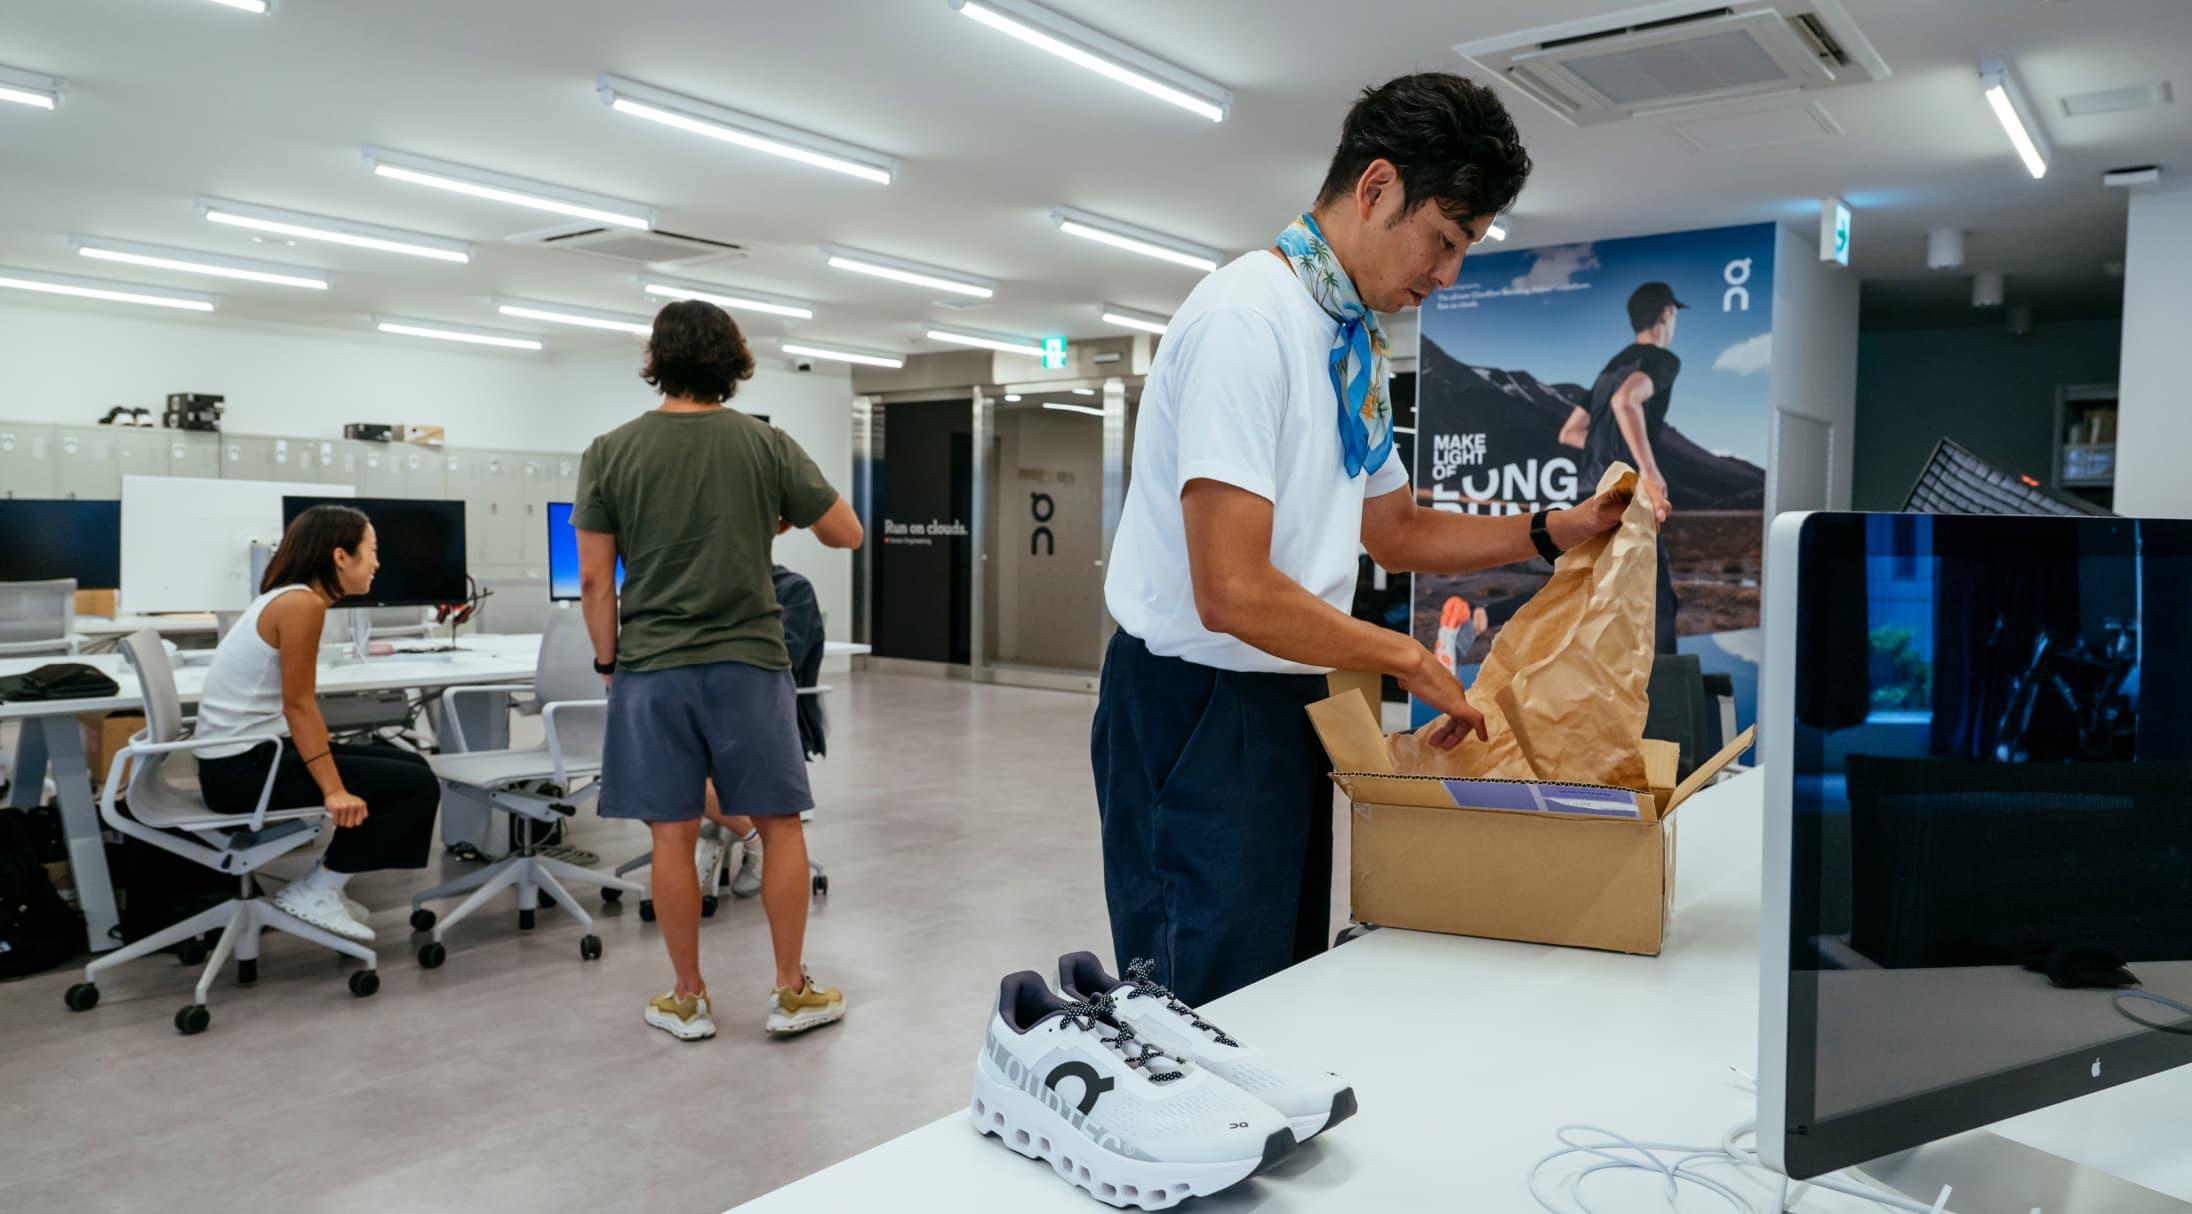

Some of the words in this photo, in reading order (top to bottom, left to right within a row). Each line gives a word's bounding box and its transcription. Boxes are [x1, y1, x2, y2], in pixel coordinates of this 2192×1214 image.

[1433, 433, 1486, 450] MAKE
[1433, 447, 1487, 466] LIGHT
[1432, 464, 1458, 480] OF
